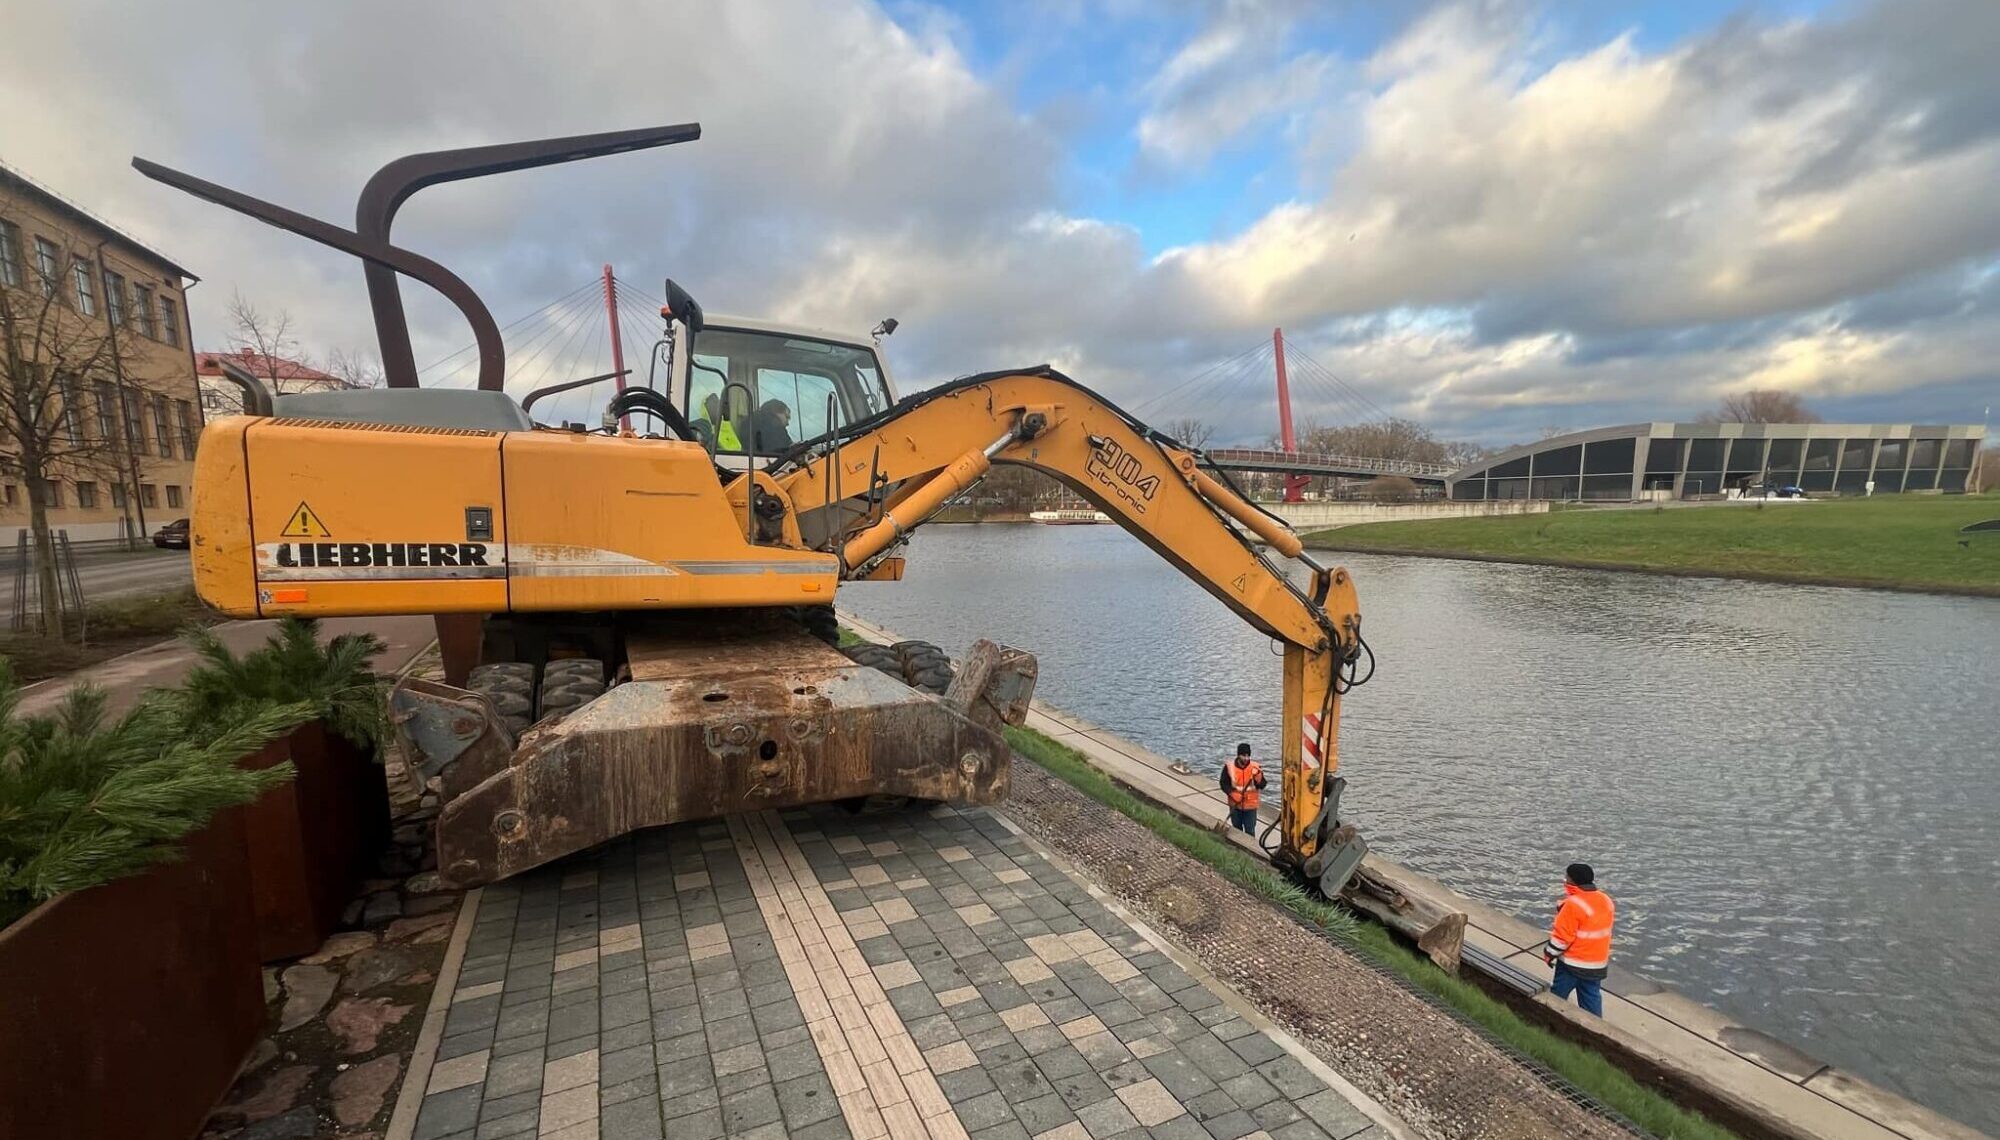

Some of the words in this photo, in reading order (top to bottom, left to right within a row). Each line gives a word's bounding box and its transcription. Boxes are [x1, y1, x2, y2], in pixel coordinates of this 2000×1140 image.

[1087, 461, 1146, 514] Litronic
[1096, 437, 1160, 501] 904
[277, 543, 489, 567] LIEBHERR
